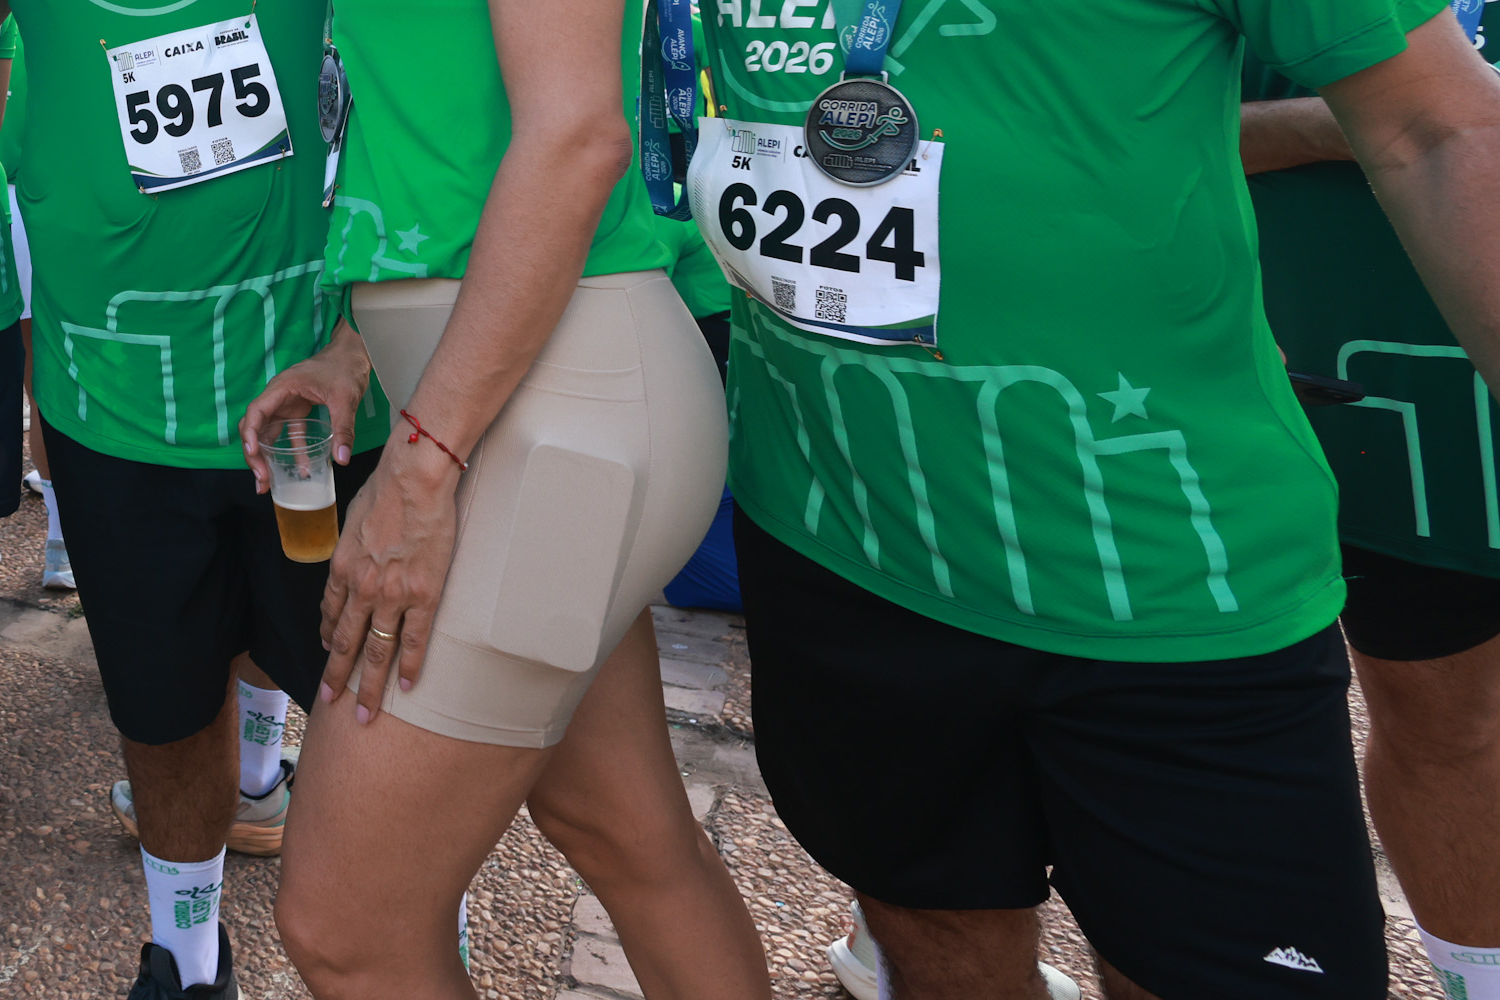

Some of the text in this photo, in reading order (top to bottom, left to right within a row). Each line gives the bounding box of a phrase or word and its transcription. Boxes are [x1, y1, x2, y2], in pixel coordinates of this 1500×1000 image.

[214, 30, 249, 46] BRASIL
[855, 15, 871, 49] CORRIDA
[862, 16, 880, 50] ALEPI
[164, 41, 204, 58] CAIXA
[670, 38, 679, 61] ALEPI
[677, 28, 687, 60] AVANÇA
[134, 51, 155, 61] ALEPI
[745, 40, 836, 75] 2026
[123, 71, 136, 84] 5K
[125, 63, 271, 145] 5975
[678, 88, 687, 118] ALEPI
[820, 100, 877, 112] CORRIDA
[820, 111, 876, 127] ALEPI
[832, 128, 862, 139] 2026
[758, 138, 781, 150] ALEPI
[651, 152, 662, 182] ALEPI
[731, 156, 751, 171] 5K
[718, 182, 925, 282] 6224
[819, 285, 843, 293] FOTOS
